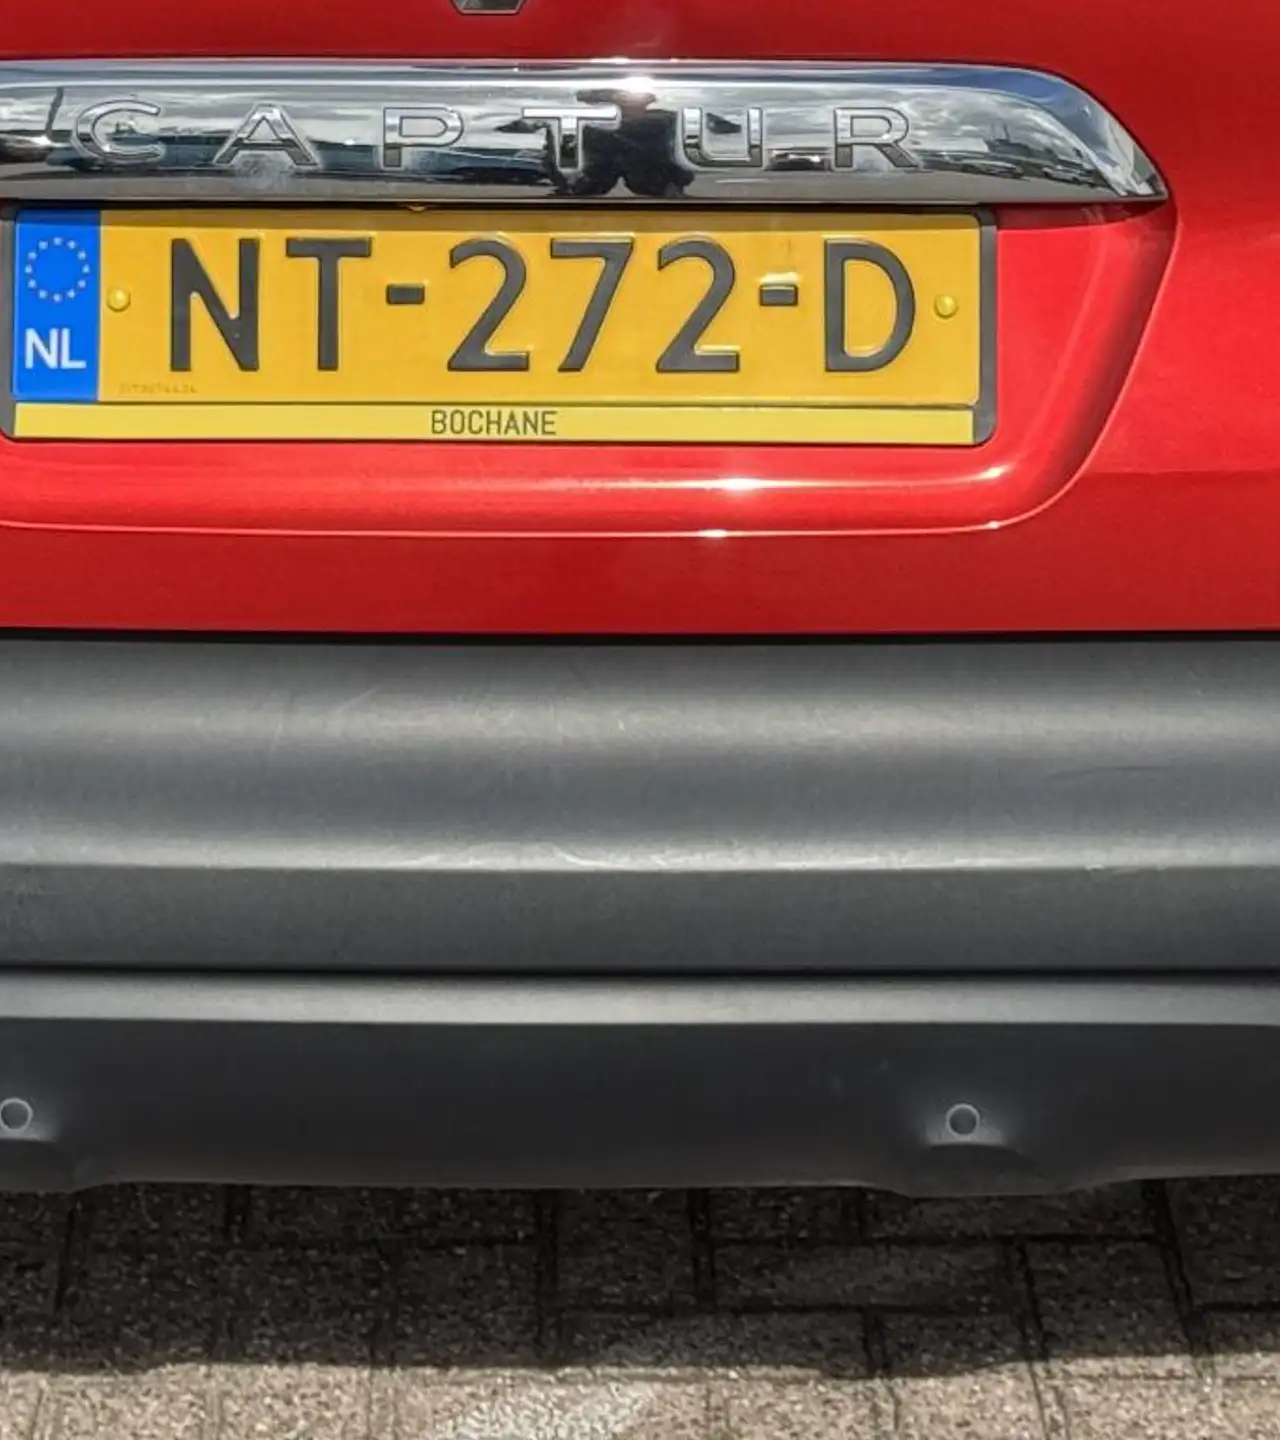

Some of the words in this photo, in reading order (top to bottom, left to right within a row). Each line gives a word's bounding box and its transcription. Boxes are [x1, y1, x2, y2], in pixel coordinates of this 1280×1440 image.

[72, 97, 923, 171] CAPTUR
[170, 237, 916, 375] NT-272-D
[24, 327, 87, 370] NL
[431, 409, 558, 436] BOCHANE
